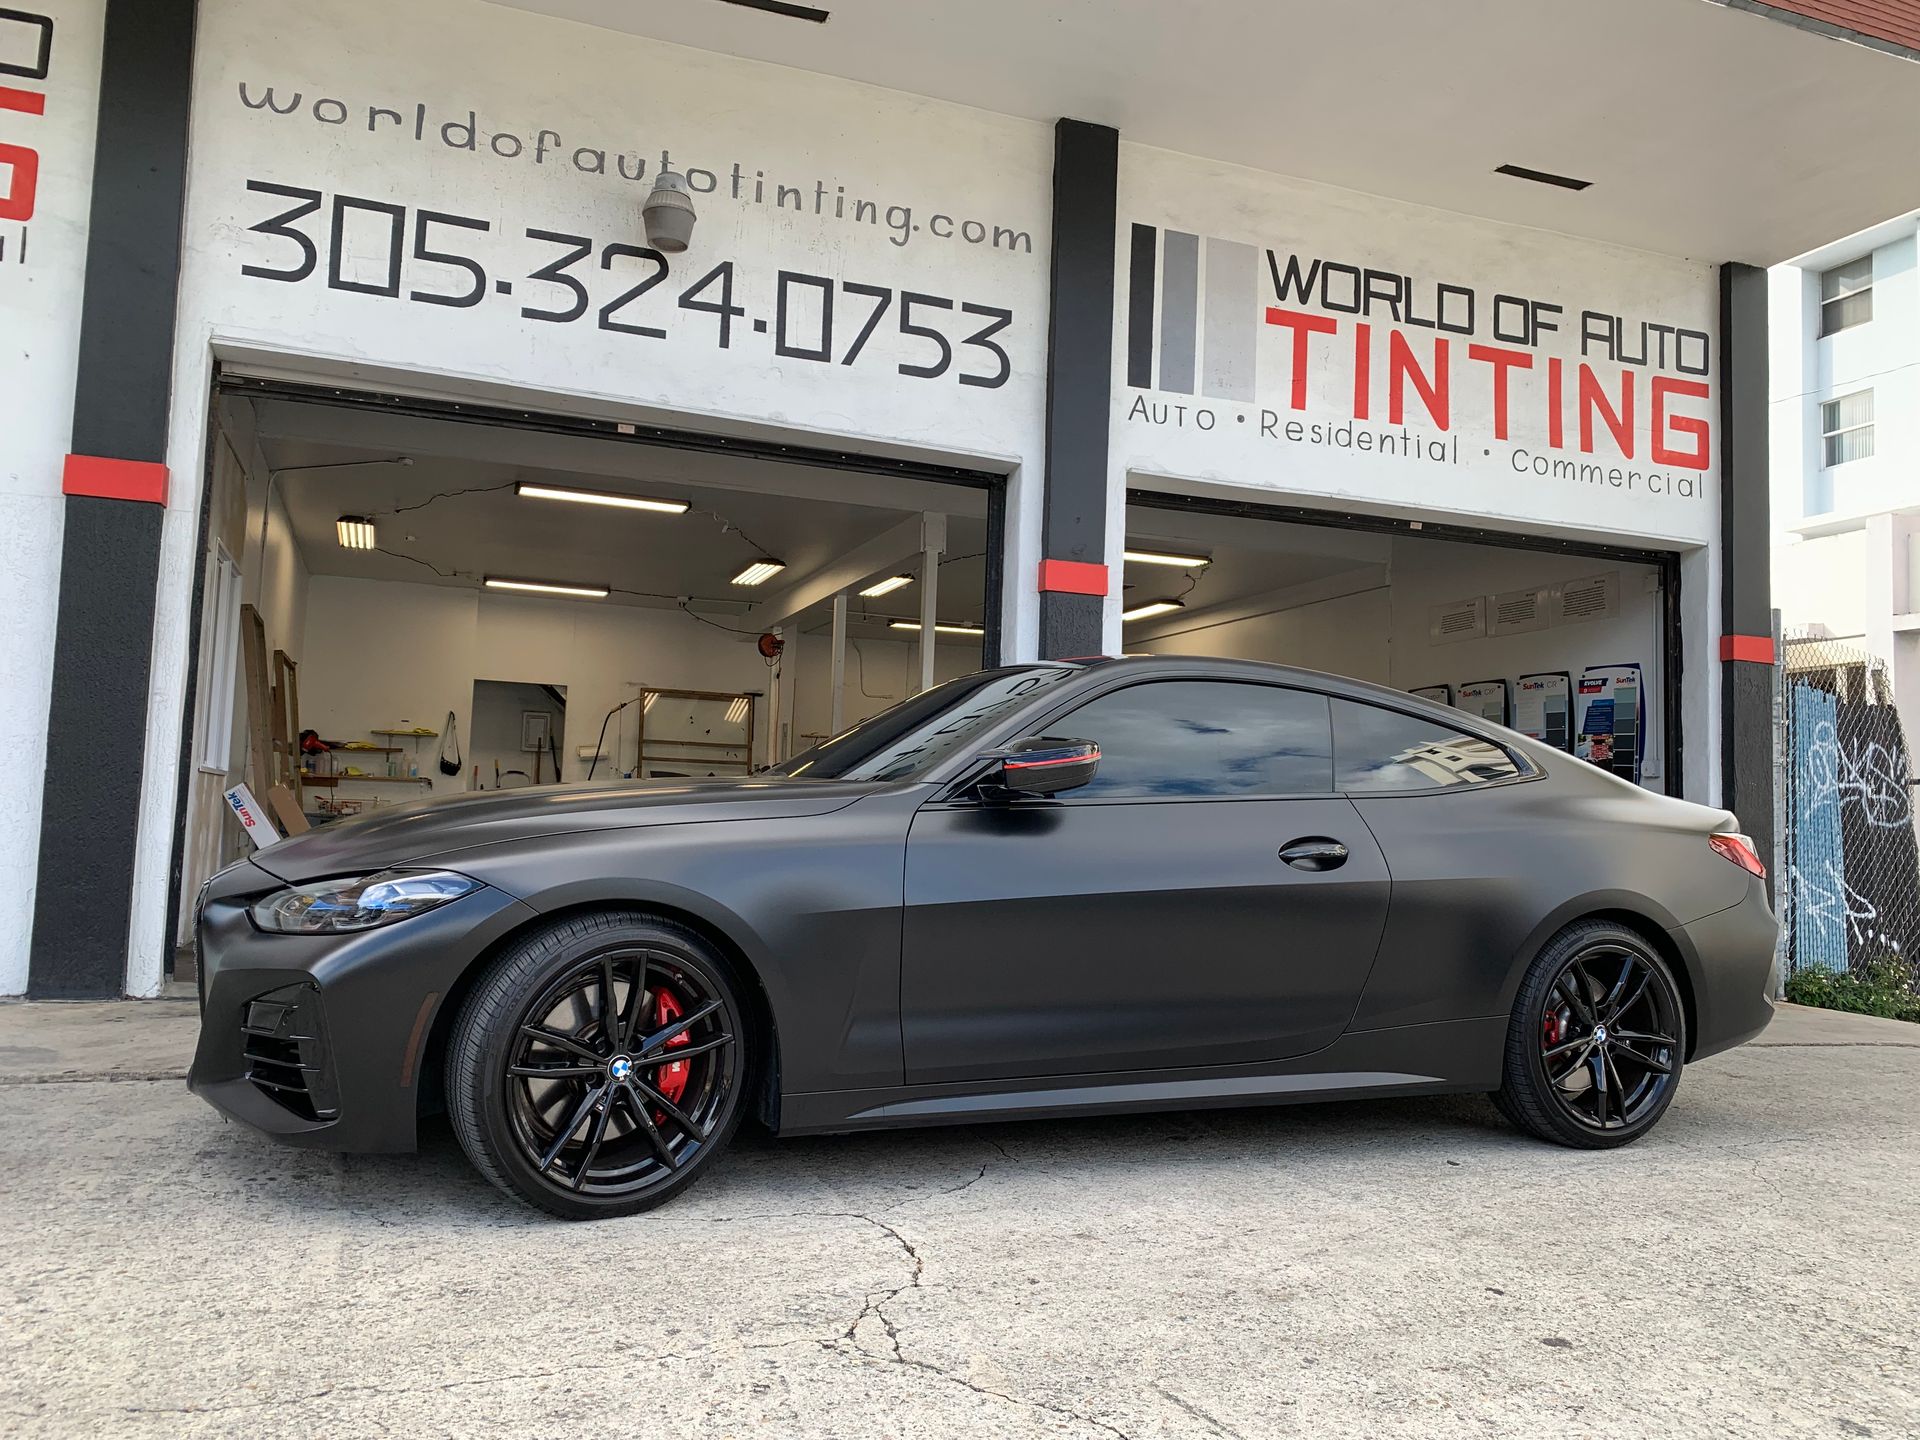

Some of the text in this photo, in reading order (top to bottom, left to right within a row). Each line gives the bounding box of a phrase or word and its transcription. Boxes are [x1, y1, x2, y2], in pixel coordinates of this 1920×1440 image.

[239, 82, 1032, 254] worldofautotinting.com
[1266, 249, 1710, 376] WORLD OF AUTO
[1265, 306, 1710, 471] TINTING
[1260, 409, 1459, 465] Residential
[1511, 448, 1704, 500] Commercial
[1522, 682, 1544, 690] SunTek
[228, 791, 256, 827] SunTek
